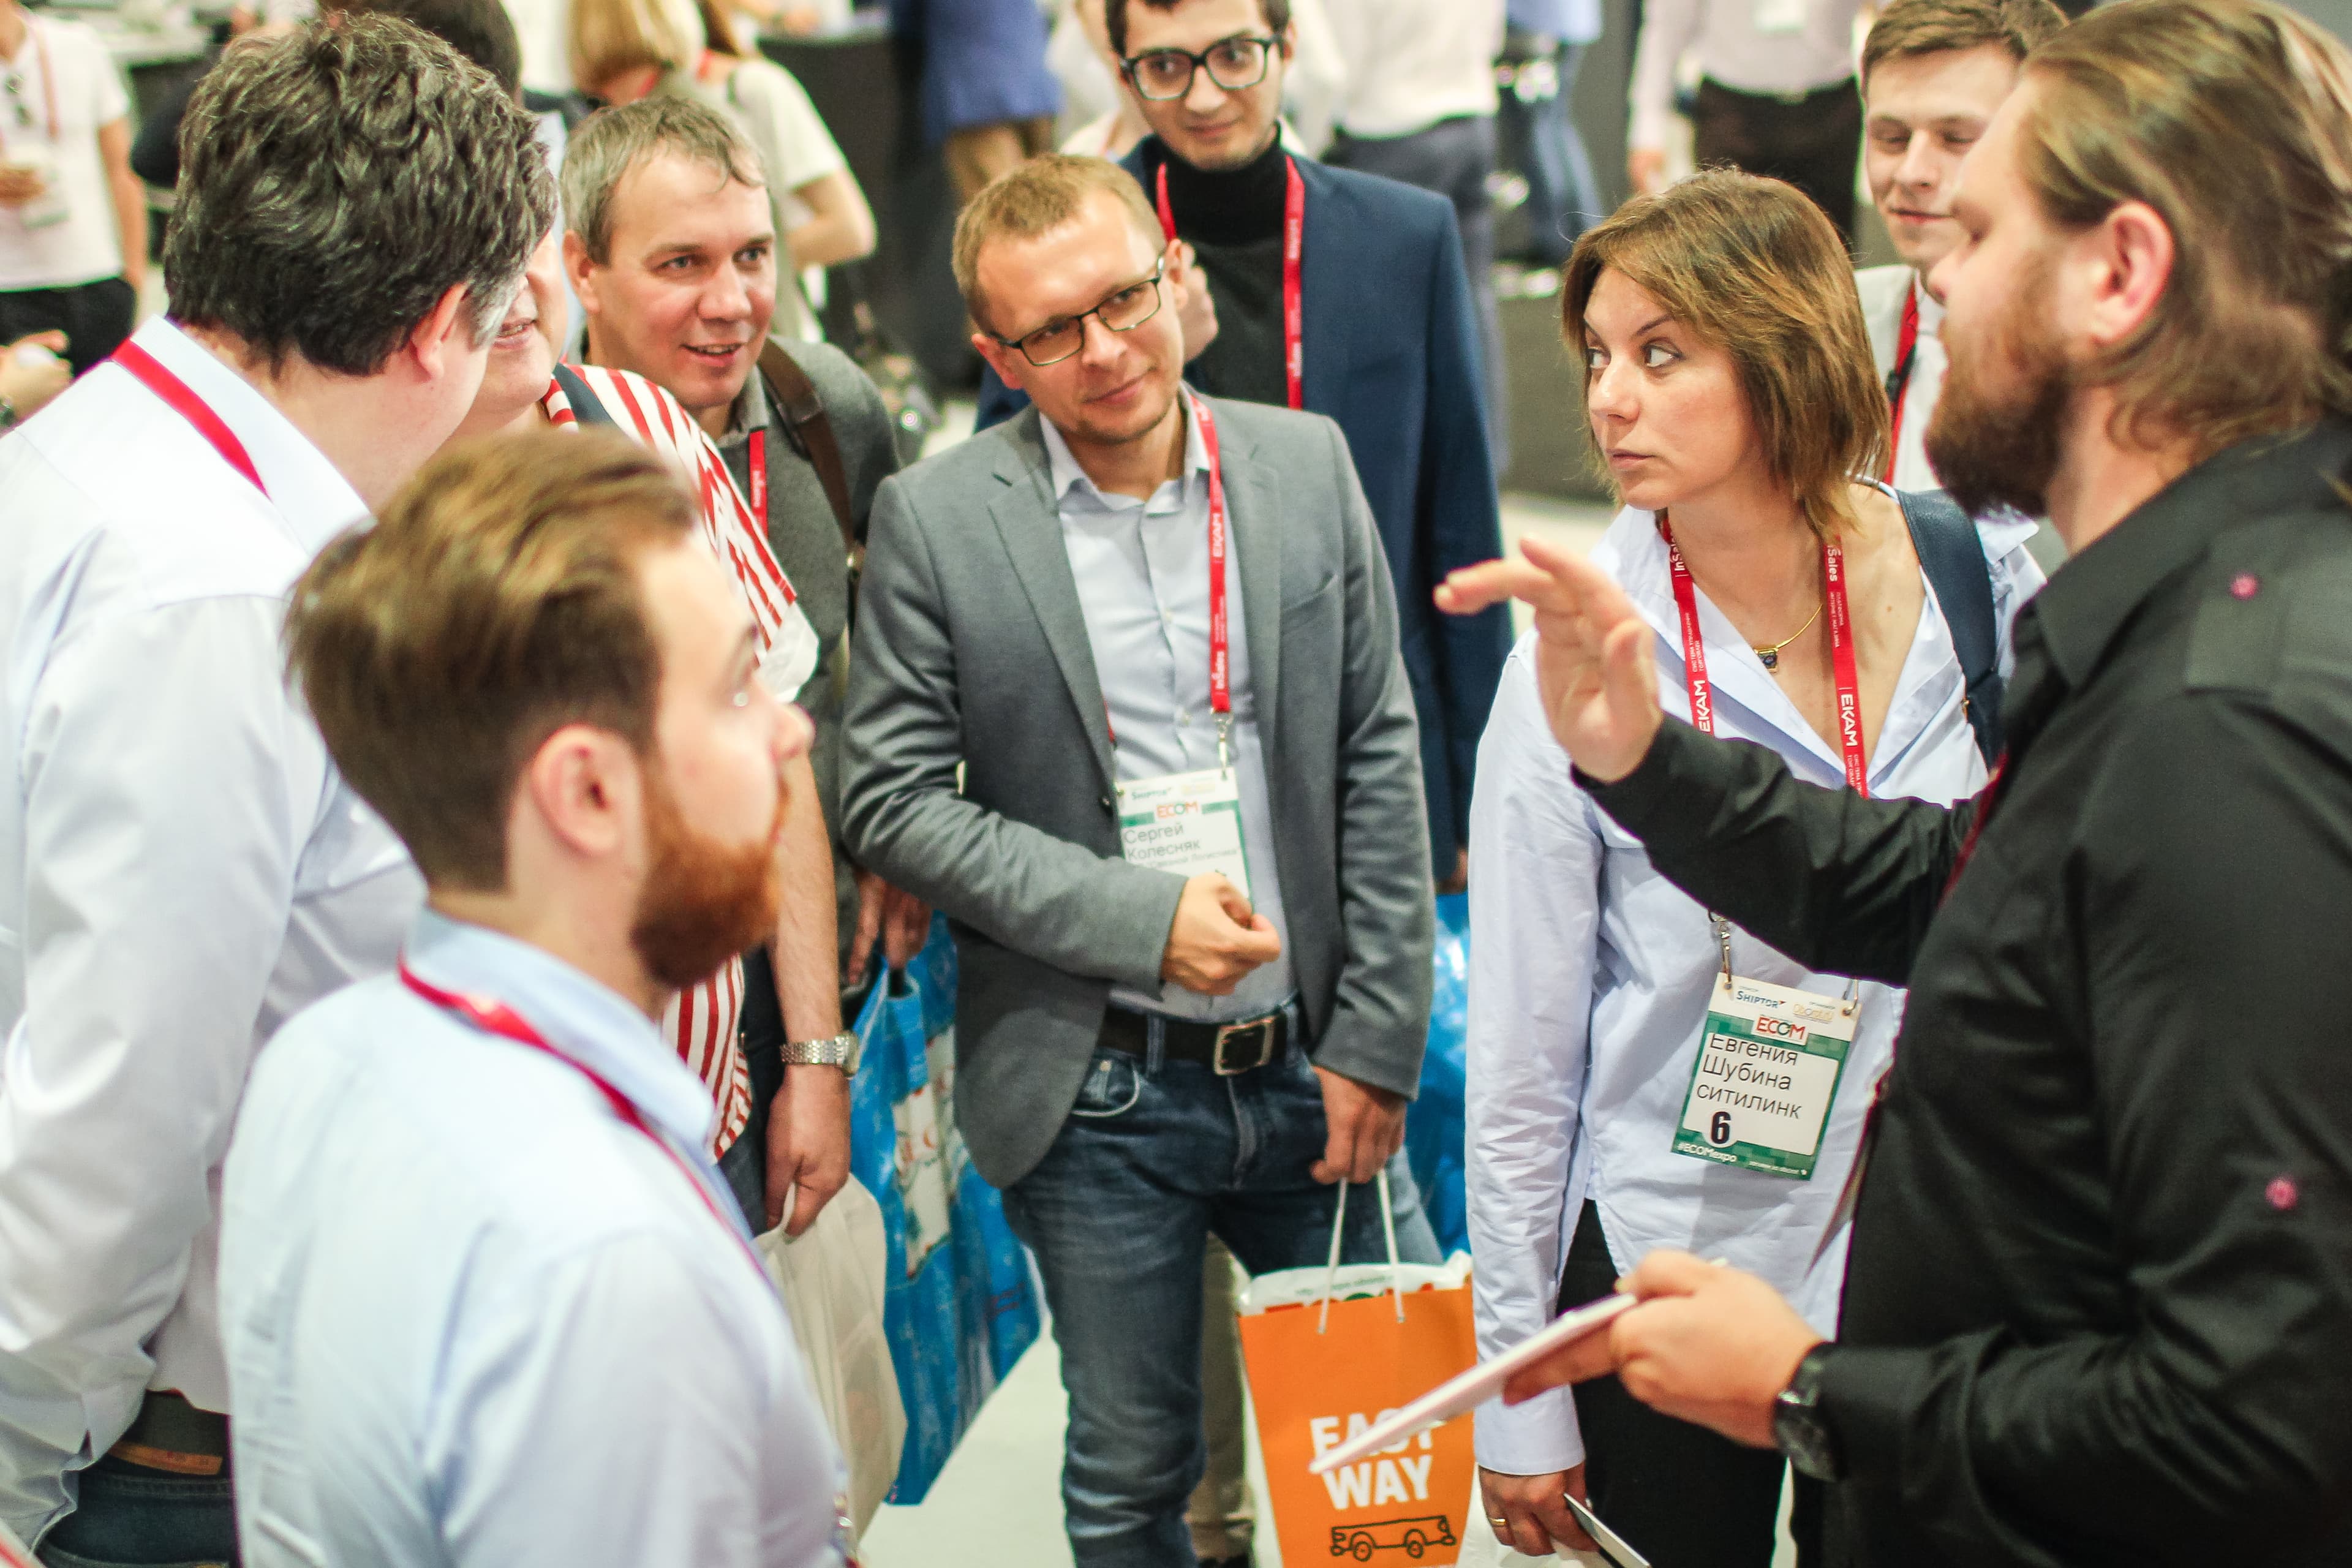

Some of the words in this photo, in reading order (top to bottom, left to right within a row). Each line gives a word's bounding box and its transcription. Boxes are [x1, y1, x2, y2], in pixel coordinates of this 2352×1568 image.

[1694, 680, 1711, 732] EKAM
[1841, 694, 1858, 747] EKAM
[1125, 823, 1184, 844] Сергей
[1128, 839, 1200, 861] Колесняк
[1757, 1016, 1806, 1040] ECOM
[1710, 1034, 1798, 1066] Евгения
[1703, 1054, 1792, 1090] Шубина
[1711, 1110, 1732, 1145] 6
[1321, 1454, 1433, 1511] WAY
